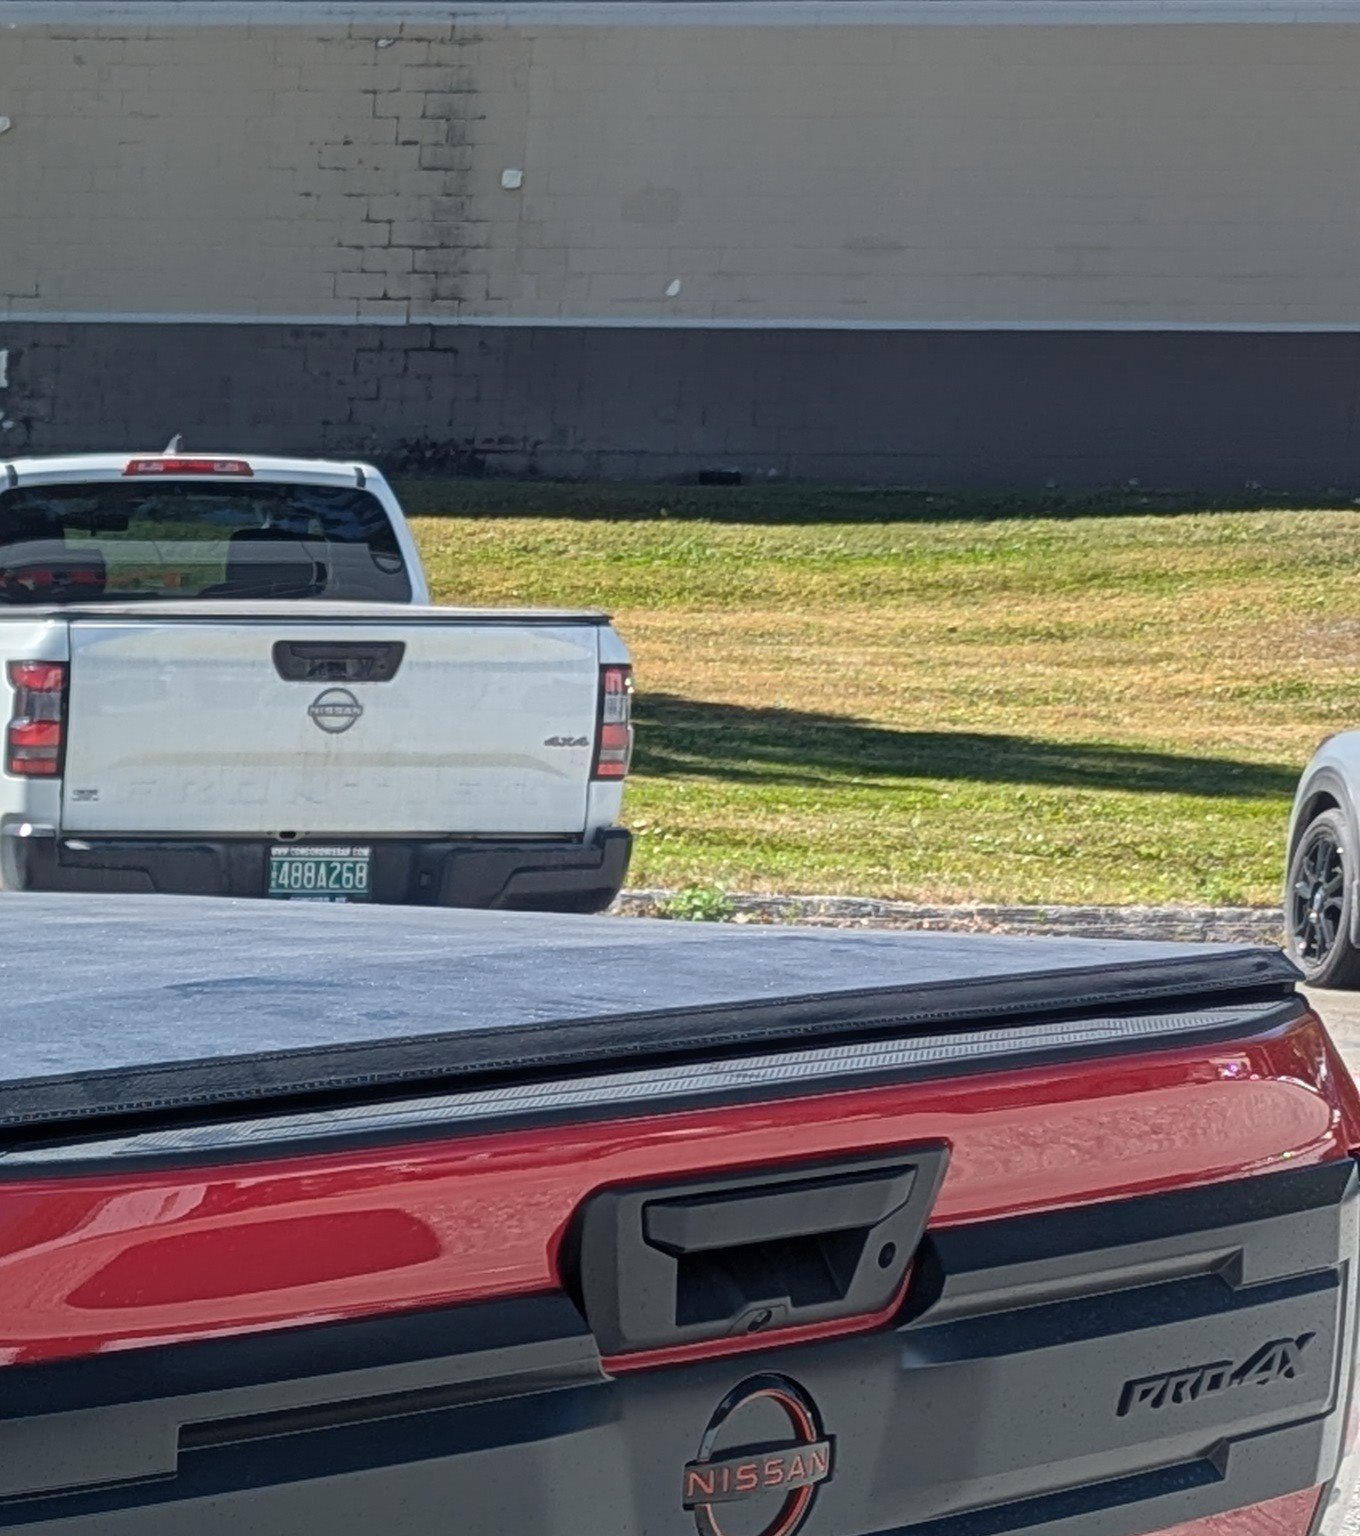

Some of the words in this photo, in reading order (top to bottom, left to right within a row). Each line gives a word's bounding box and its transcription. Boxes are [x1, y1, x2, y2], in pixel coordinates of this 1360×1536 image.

[278, 860, 368, 889] 488A268
[1115, 1331, 1318, 1418] PRO-4X
[686, 1446, 830, 1498] NISSAN
